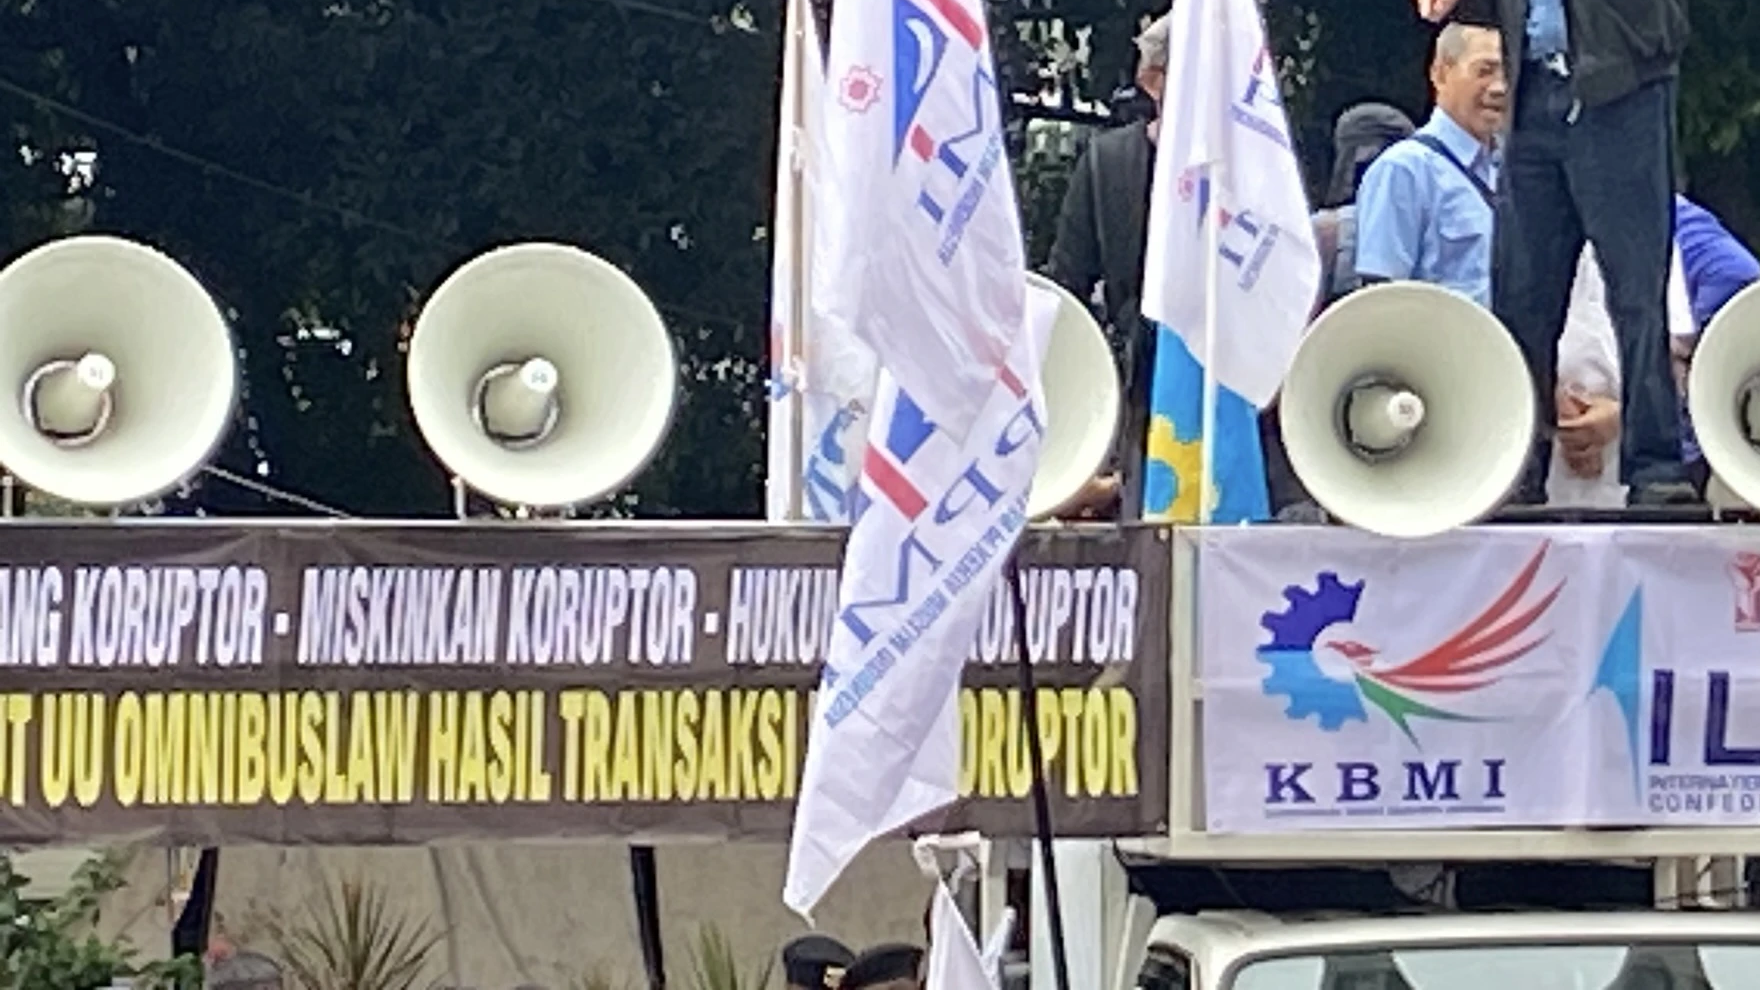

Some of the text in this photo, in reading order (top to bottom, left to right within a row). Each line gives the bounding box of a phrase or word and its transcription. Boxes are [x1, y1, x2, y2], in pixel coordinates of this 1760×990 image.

[69, 566, 267, 665] KORUPTOR
[299, 566, 502, 666] MISKINKAN
[507, 566, 698, 665] KORUPTOR
[42, 692, 105, 808] UU
[114, 690, 419, 808] OMNIBUSLAW
[428, 690, 551, 804] HASIL
[559, 690, 798, 803] TRANSAKSI
[957, 687, 1139, 799] ORUPTOR
